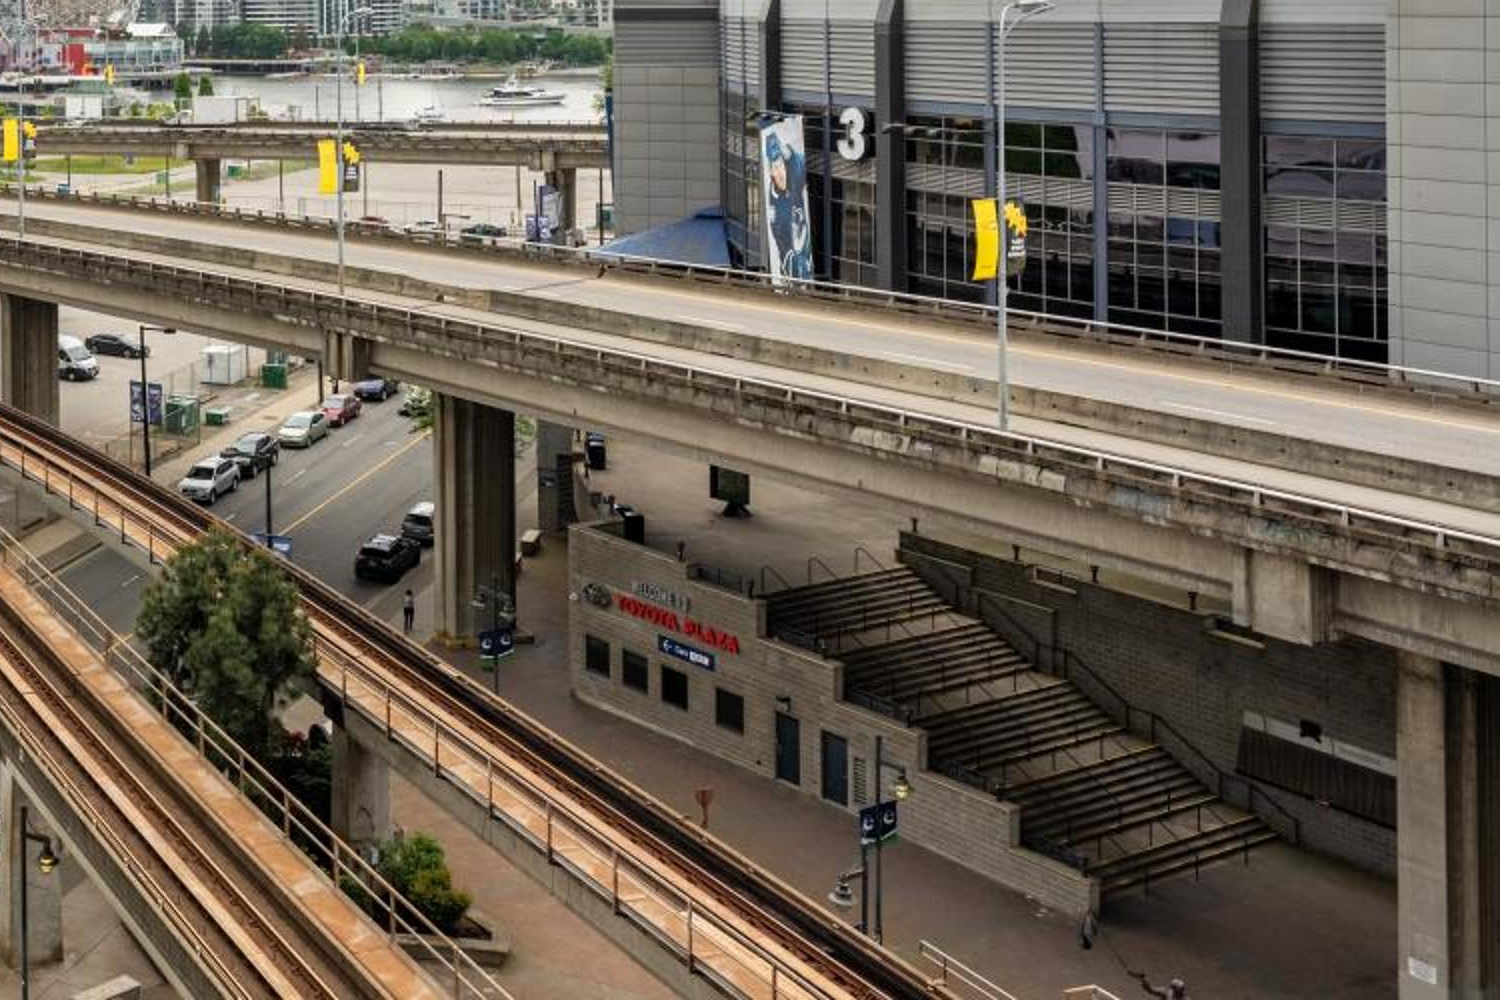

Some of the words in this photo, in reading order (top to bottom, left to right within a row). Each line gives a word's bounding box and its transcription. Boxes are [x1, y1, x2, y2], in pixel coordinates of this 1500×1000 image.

[837, 107, 866, 161] 3
[612, 592, 681, 632] TOYOTA
[682, 616, 741, 656] PLAZA
